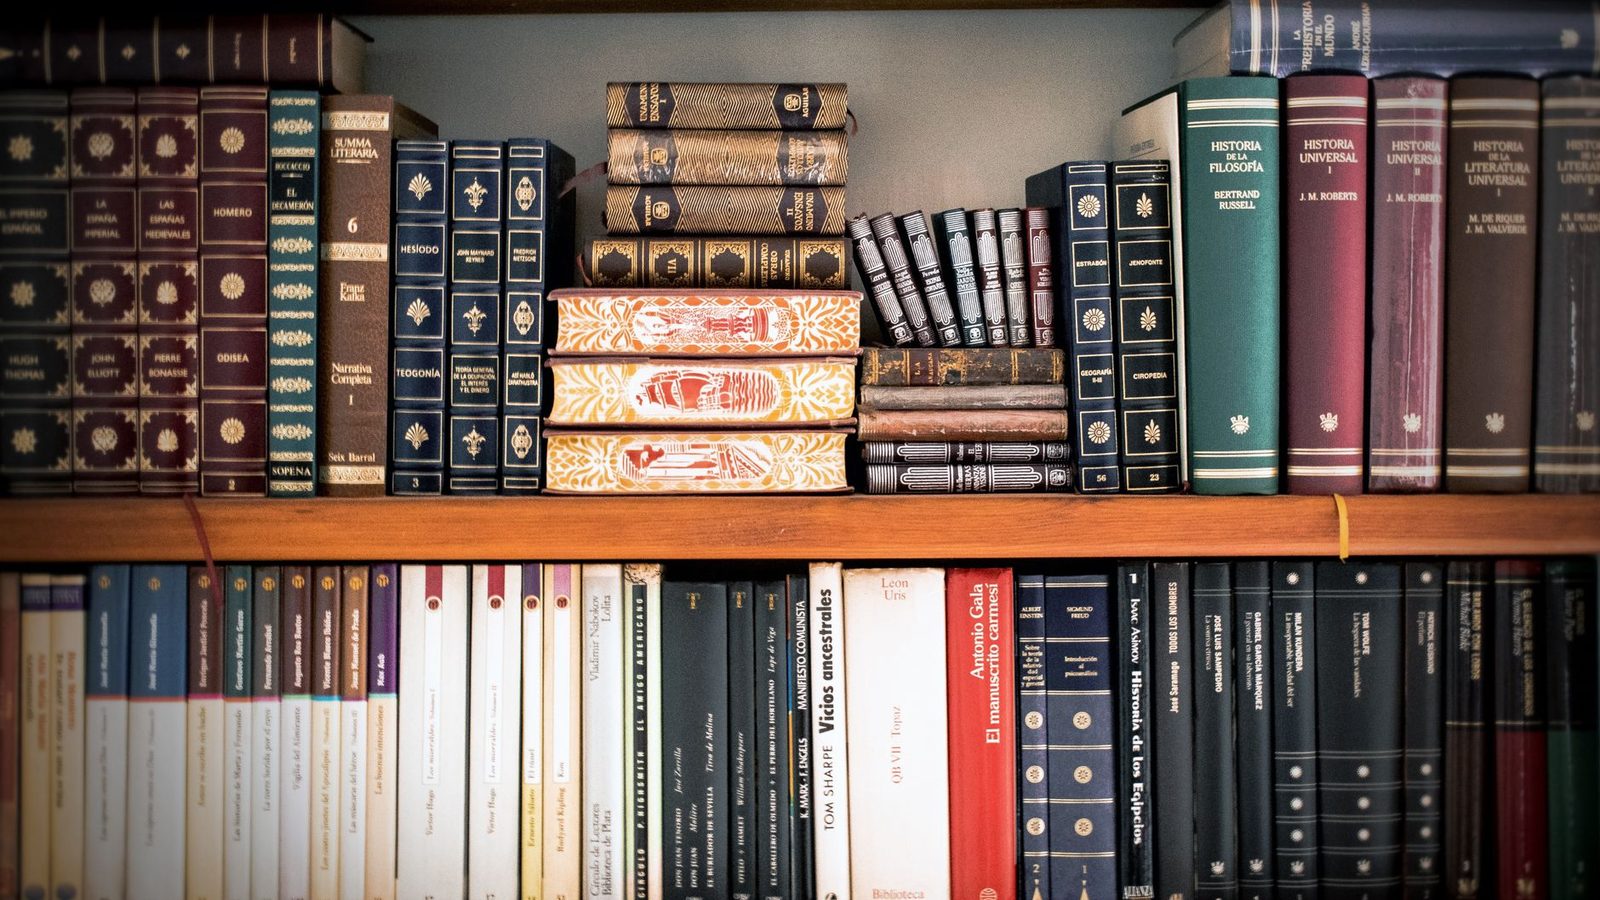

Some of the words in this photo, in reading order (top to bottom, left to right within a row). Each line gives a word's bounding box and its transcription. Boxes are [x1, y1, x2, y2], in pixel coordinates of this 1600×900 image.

[1302, 2, 1312, 71] PREHISTORIA
[1324, 14, 1334, 57] MUNDO
[1352, 20, 1360, 51] ANDRÉ
[334, 138, 372, 148] SUMMA
[1210, 141, 1262, 151] HISTORIA
[1304, 140, 1354, 150] HISTORIA
[1392, 140, 1441, 152] HISTORIA
[1473, 141, 1524, 152] HISTORIA
[330, 148, 378, 159] LITERARIA
[1300, 152, 1358, 164] UNIVERSAL
[1387, 154, 1443, 165] UNIVERSAL
[275, 162, 310, 172] BOCCACCIO
[1210, 160, 1264, 173] FILOSOFÍA
[1465, 163, 1530, 175] LITERATURA
[1468, 175, 1527, 186] UNIVERSAL
[286, 187, 297, 198] EL
[1214, 190, 1260, 200] BERTRAND
[1320, 192, 1358, 201] ROBERTS
[160, 200, 174, 210] LAS
[213, 207, 252, 218] HOMERO
[272, 200, 314, 212] DECAMERÓN
[794, 192, 804, 232] ENSAYOS
[806, 192, 814, 232] UNAMUNO
[1219, 200, 1256, 210] RUSSELL
[86, 213, 118, 224] ESPAÑA
[150, 213, 185, 225] ESPAÑAS
[347, 218, 358, 233] 6
[1494, 214, 1525, 225] RIQUER
[85, 229, 120, 240] IMPERIAL
[145, 230, 190, 240] MEDIEVALES
[1486, 225, 1526, 234] VALVERDE
[401, 244, 439, 254] HESÍODO
[668, 258, 677, 274] VII
[1076, 259, 1107, 268] ESTRABÓN
[340, 283, 365, 293] Franz
[340, 292, 365, 302] Kafka
[92, 354, 115, 364] JOHN
[155, 354, 182, 364] PIERRE
[217, 353, 250, 364] ODISEA
[332, 363, 372, 374] Narrativa
[396, 368, 440, 378] TEOGONÍA
[1081, 368, 1112, 376] GEOGRAFÍA
[331, 374, 372, 385] Completa
[328, 452, 345, 462] Seix
[348, 452, 376, 462] Barral
[272, 466, 312, 476] SOPENA
[412, 478, 419, 488] 3
[884, 590, 906, 601] Uris
[970, 584, 984, 618] Gala
[1168, 582, 1178, 615] NOMBRES
[590, 595, 600, 637] Nabokov
[601, 595, 611, 622] Lolita
[985, 583, 999, 641] carmesí
[636, 598, 644, 665] AMERICANO
[768, 626, 776, 642] Vega
[796, 600, 806, 654] COMUNISTA
[816, 589, 833, 681] ancestrales
[1254, 612, 1262, 642] GABRIEL
[1169, 632, 1178, 654] TODOS
[969, 623, 985, 680] Antonio
[1254, 645, 1264, 672] GARCÍA
[590, 641, 600, 681] Vladimir
[768, 655, 776, 673] Lope
[1169, 661, 1179, 695] Saramago
[1214, 652, 1222, 692] SAMPEDRO
[1285, 660, 1294, 684] levedad
[796, 656, 807, 710] MANIFIESTO
[985, 644, 999, 724] manuscrito
[636, 674, 645, 710] AMIGO
[1254, 674, 1263, 710] MÁRQUEZ
[819, 685, 835, 734] Vicios
[706, 713, 714, 740] Molina
[890, 706, 903, 736] Topaz
[986, 728, 1000, 744] El
[736, 732, 745, 774] Shakespeare
[799, 738, 808, 769] ENGELS
[891, 746, 902, 764] VII
[674, 747, 682, 777] Zorrilla
[706, 753, 714, 772] Tirso
[822, 745, 834, 796] SHARPE
[891, 766, 903, 784] QB
[636, 751, 645, 816] HIGHSMITH
[736, 776, 745, 806] William
[800, 783, 809, 808] MARX
[590, 803, 600, 842] Lectores
[602, 810, 612, 833] Plata
[689, 804, 698, 832] Molière
[824, 802, 835, 831] TOM
[602, 835, 612, 847] de
[590, 856, 600, 896] Círculo
[602, 850, 612, 895] Biblioteca
[1033, 864, 1039, 872] 2
[873, 889, 924, 900] Biblioteca
